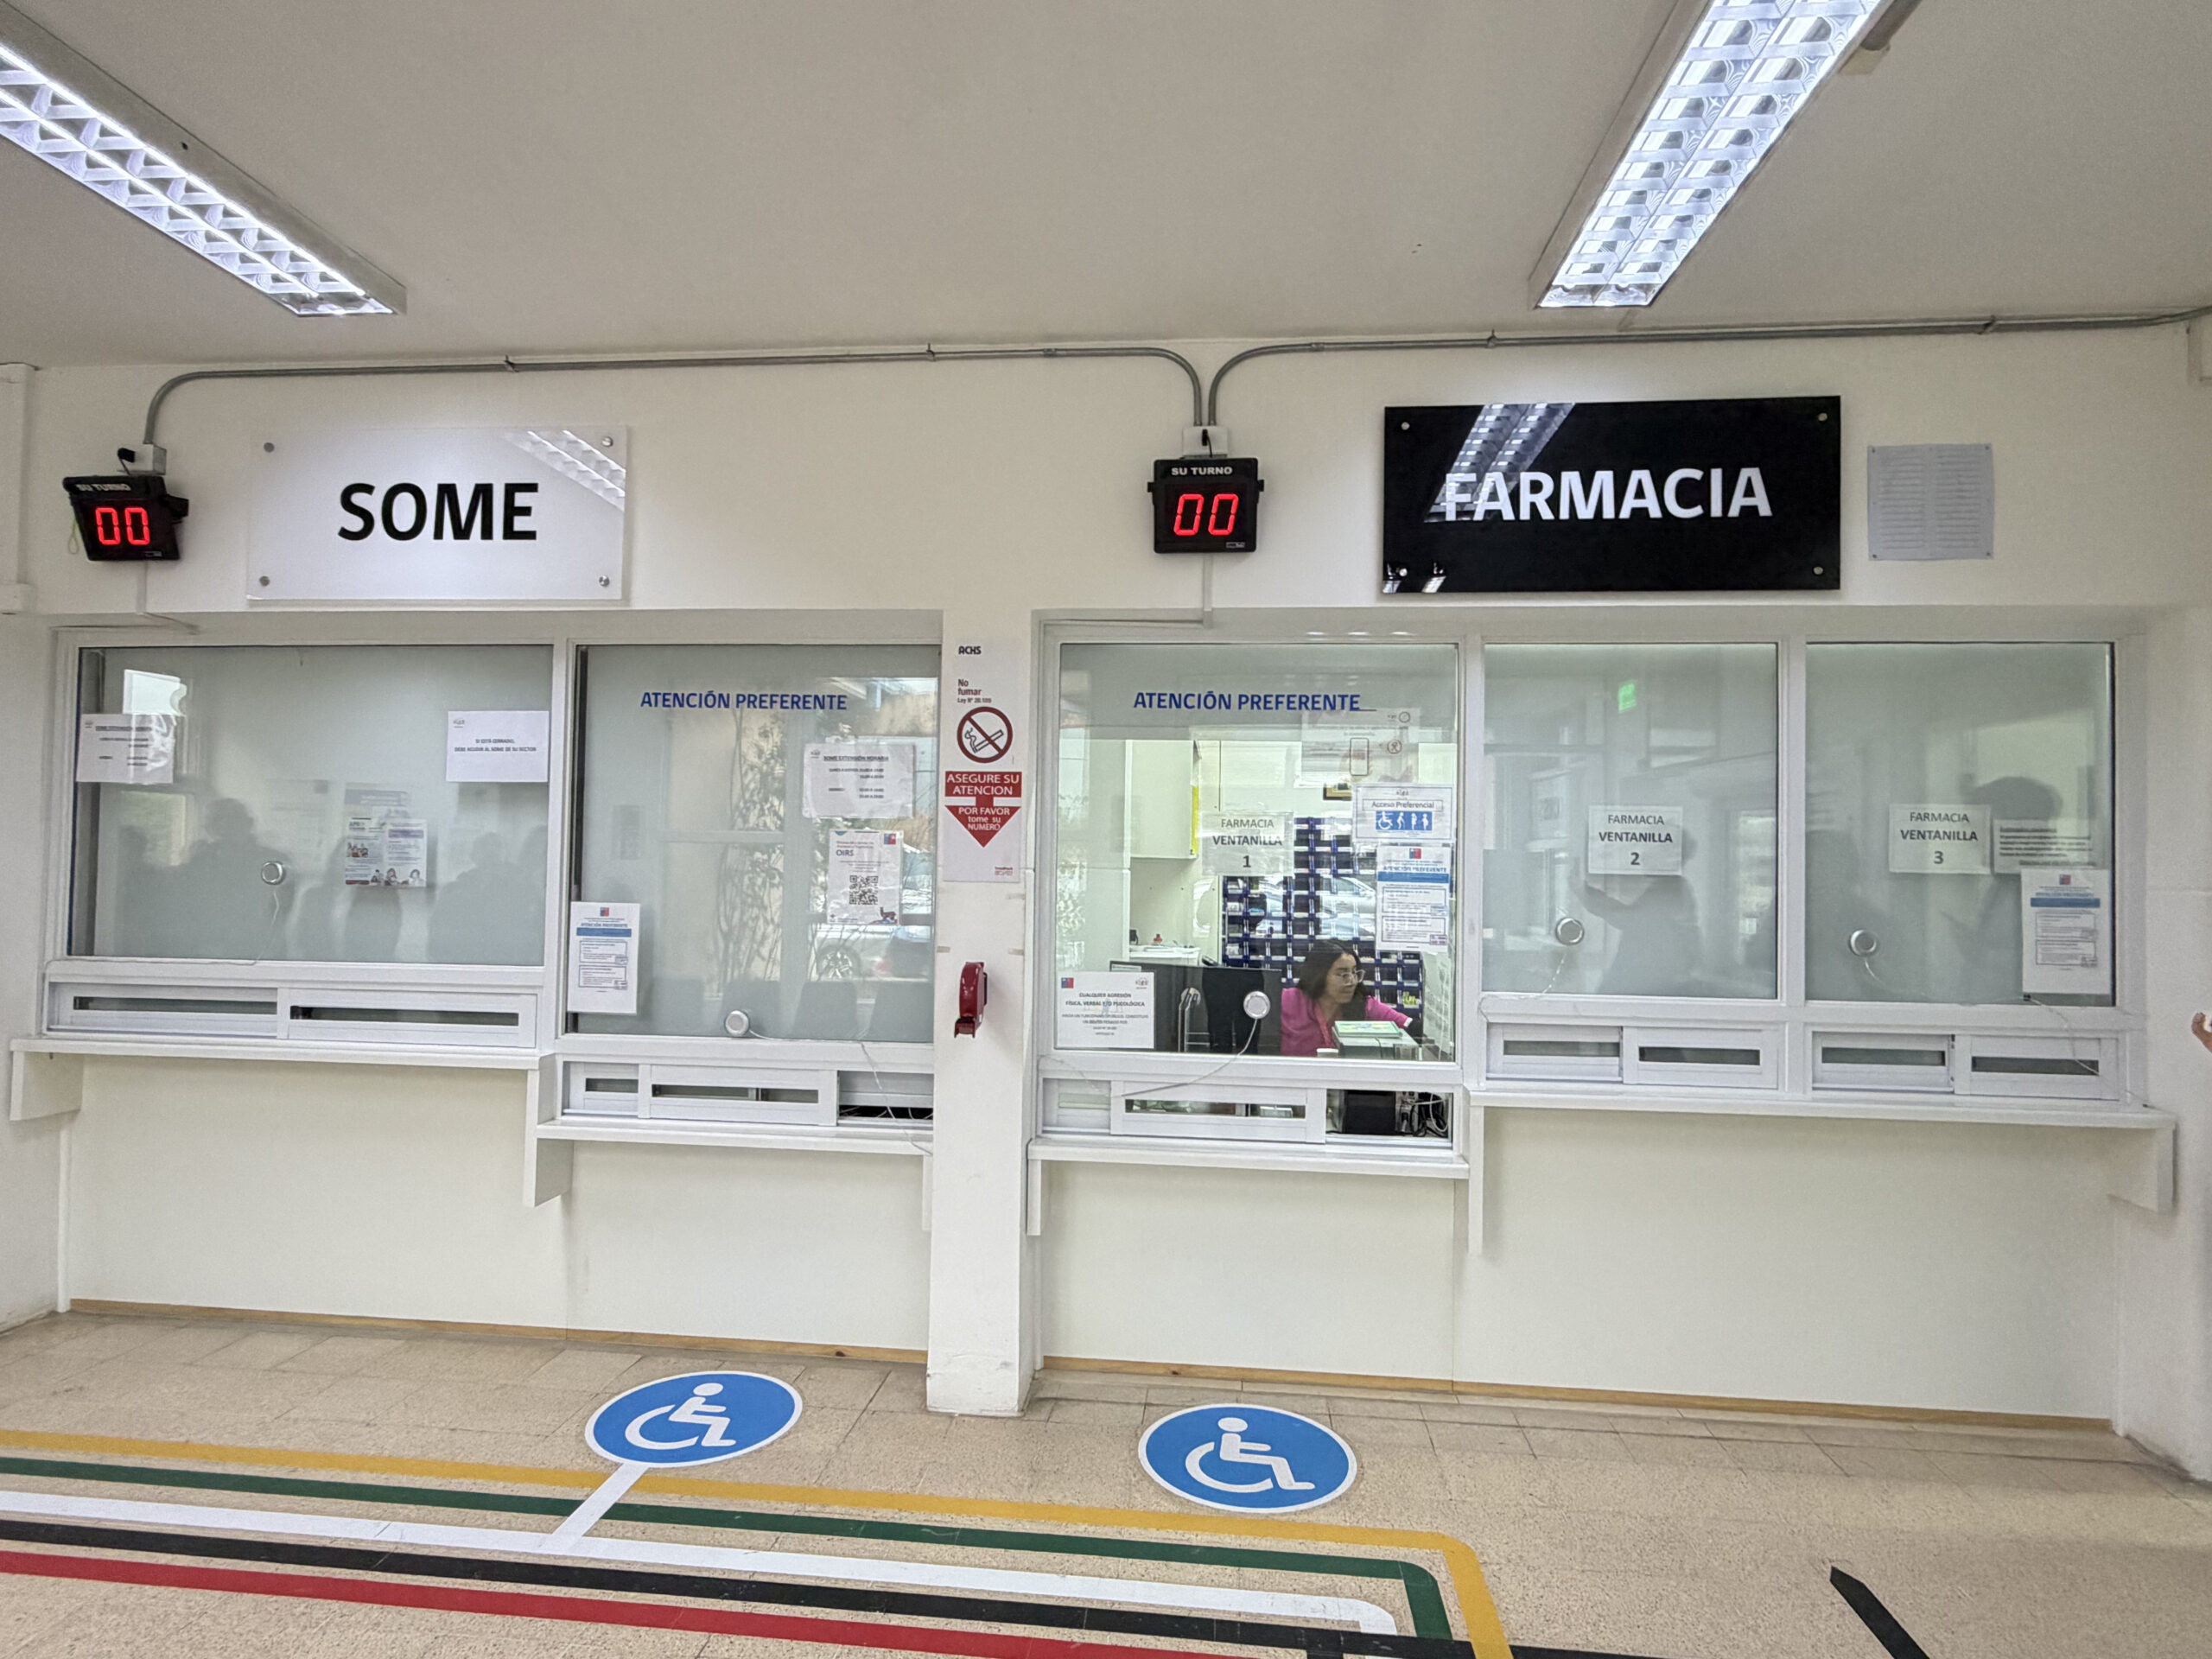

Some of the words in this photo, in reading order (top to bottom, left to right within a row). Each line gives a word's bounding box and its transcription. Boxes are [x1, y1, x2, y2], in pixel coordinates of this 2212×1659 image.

[1171, 467, 1187, 476] SU
[1191, 467, 1233, 475] TURNO
[1444, 467, 1773, 522] FARMACIA
[337, 482, 539, 541] SOME
[1173, 493, 1239, 536] 00
[95, 507, 150, 545] 00
[958, 645, 982, 655] ACHS
[957, 678, 969, 687] No
[640, 690, 730, 709] ATENCIÓN
[736, 694, 848, 710] PREFERENTE
[1134, 691, 1231, 709] ATENCIÓN
[1238, 694, 1361, 711] PREFERENTE
[947, 774, 1001, 784] ASEGURE
[1003, 774, 1020, 784] SU
[952, 785, 1013, 795] ATENCION
[1607, 815, 1665, 825] FARMACIA
[1910, 811, 1969, 823] FARMACIA
[1221, 818, 1274, 828] FARMACIA
[1212, 836, 1282, 846] VENTANILLA
[1599, 831, 1673, 842] VENTANILLA
[1900, 830, 1978, 841] VENTANILLA
[1243, 855, 1251, 868] 1
[1630, 852, 1641, 865] 2
[1934, 850, 1944, 864] 3
